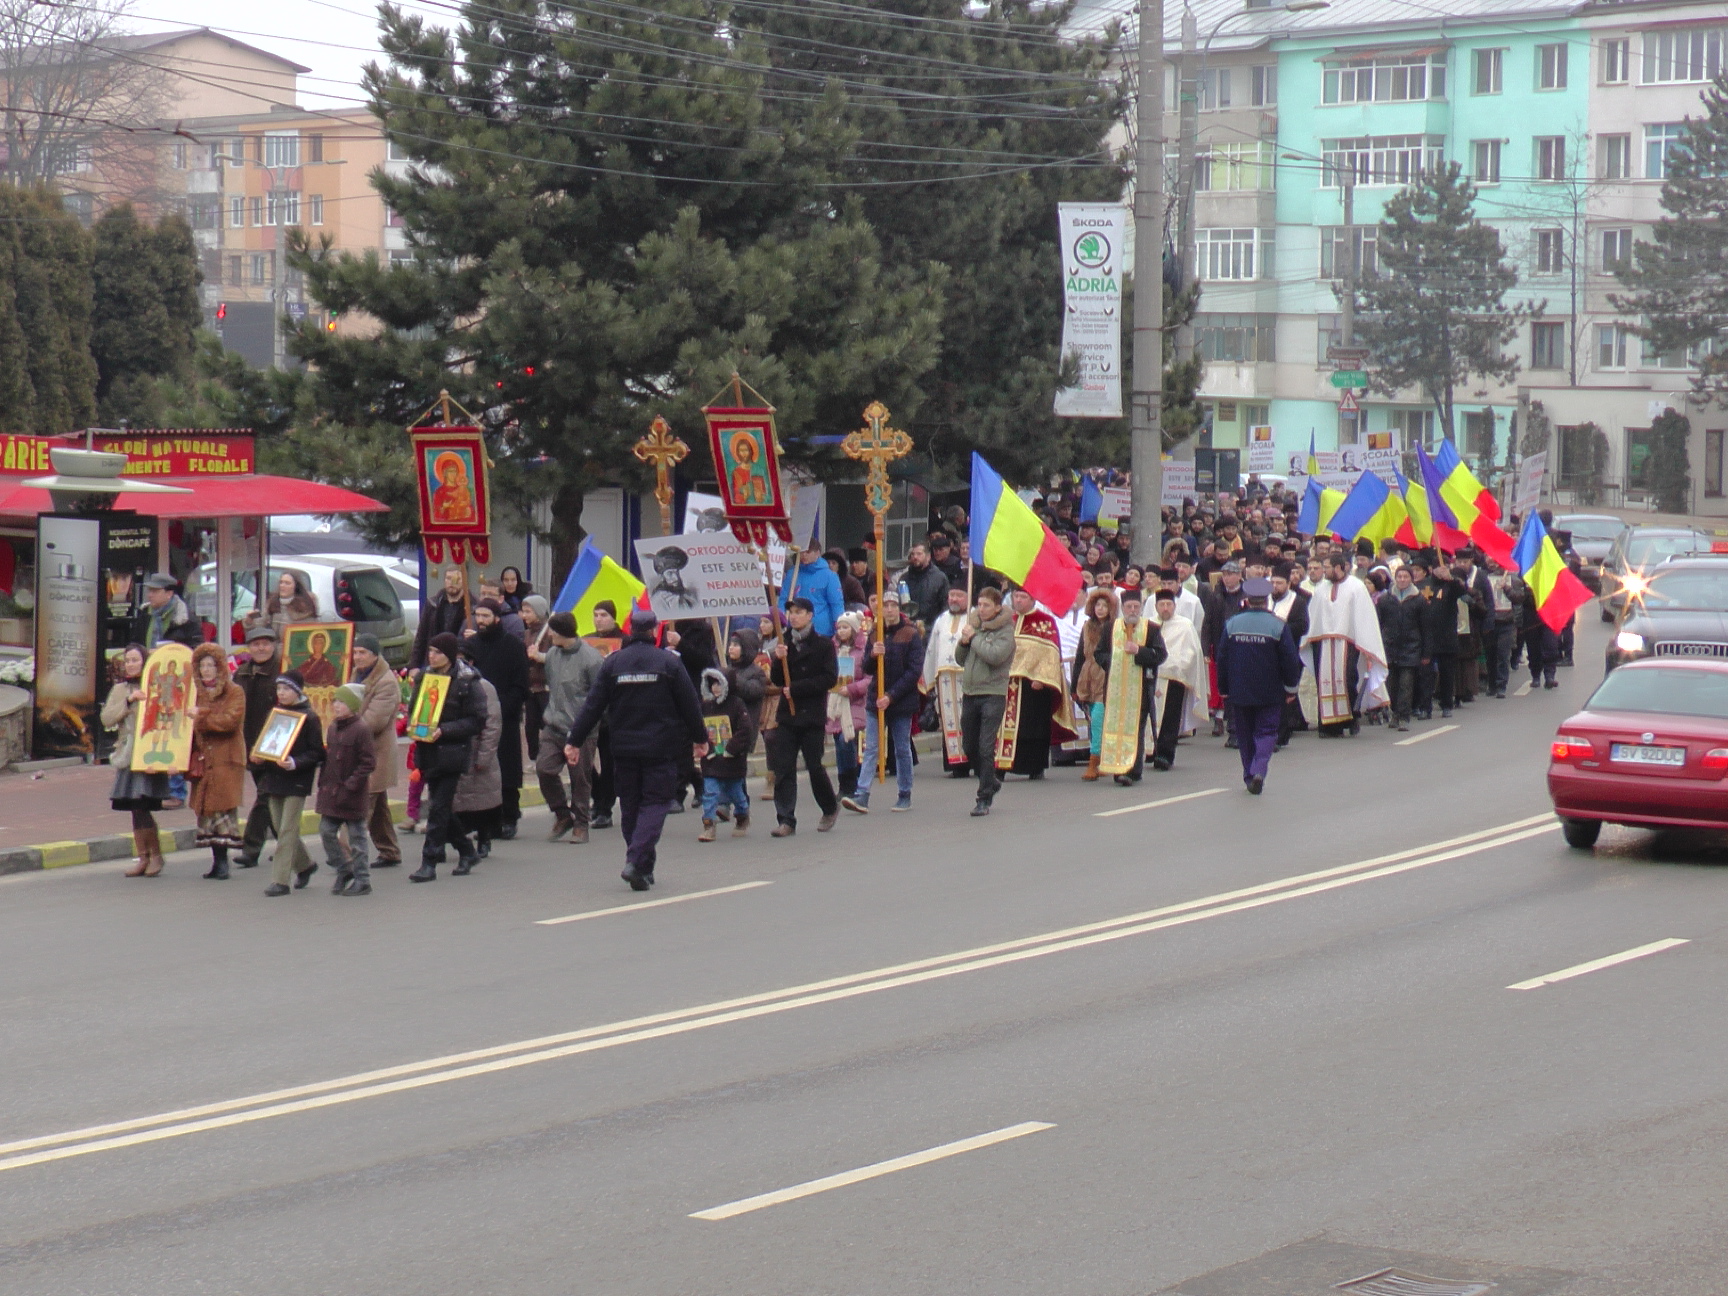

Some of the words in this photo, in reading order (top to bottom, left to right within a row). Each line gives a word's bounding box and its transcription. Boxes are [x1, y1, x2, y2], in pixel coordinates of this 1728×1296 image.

[1067, 277, 1118, 292] ADRIA
[1067, 342, 1112, 351] Showroom
[1080, 353, 1105, 361] ervice
[152, 440, 228, 457] NATURALE
[189, 458, 248, 472] FLORALE
[701, 562, 725, 573] ESTE
[730, 562, 757, 571] SEVA
[706, 580, 763, 590] NEAMULUI
